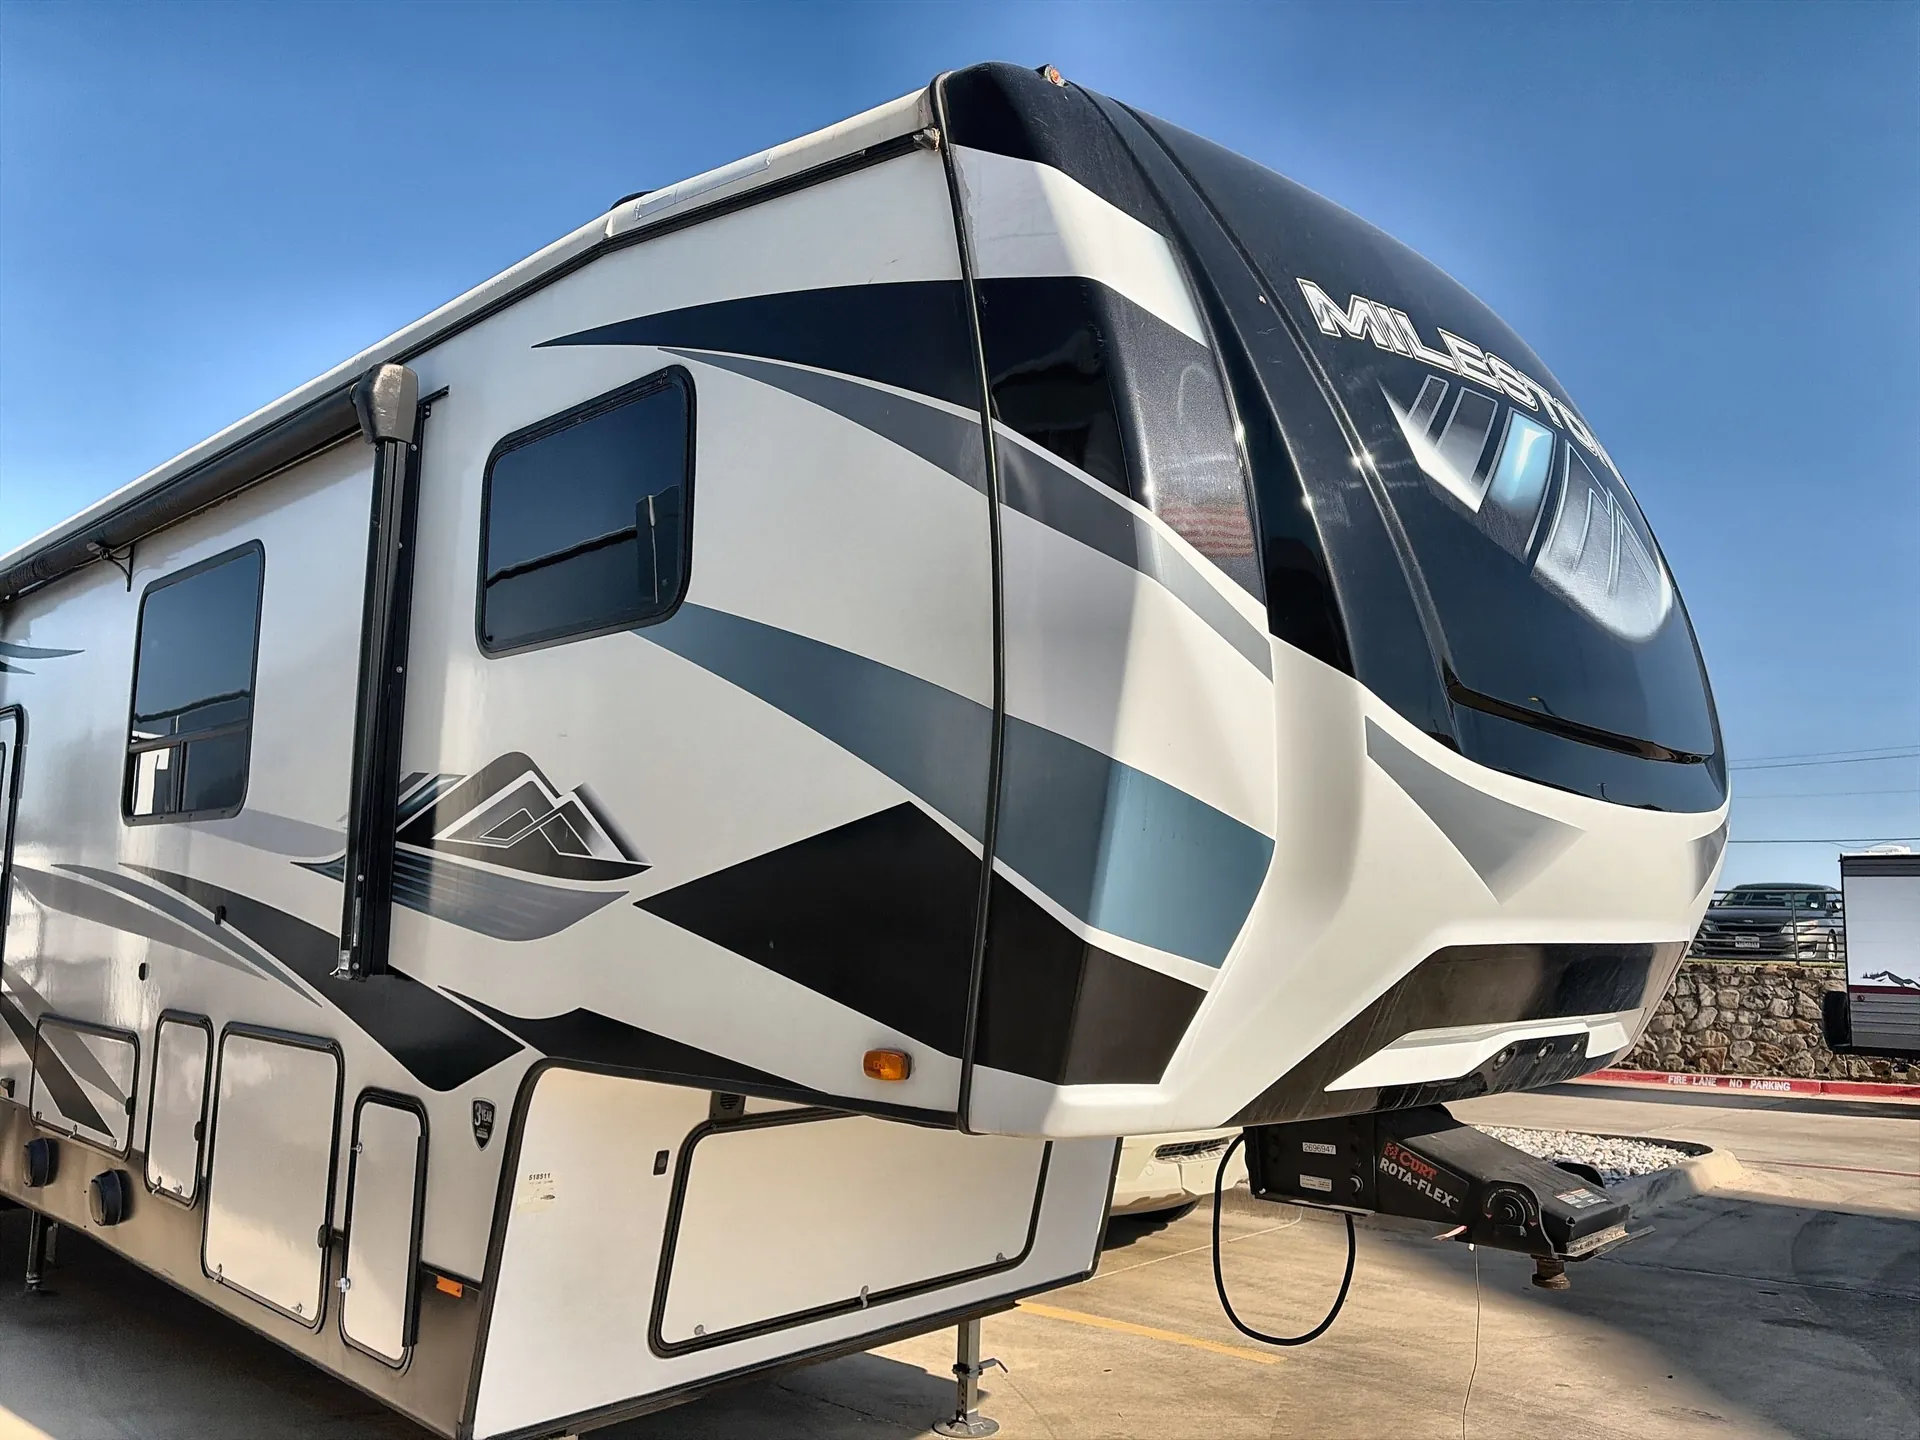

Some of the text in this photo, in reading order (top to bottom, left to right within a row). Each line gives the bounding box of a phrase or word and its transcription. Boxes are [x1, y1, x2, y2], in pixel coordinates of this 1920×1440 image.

[1668, 1075, 1791, 1091] FIRE LANE NO PARKING
[475, 1102, 482, 1126] 3
[1304, 1143, 1335, 1153] 2696947
